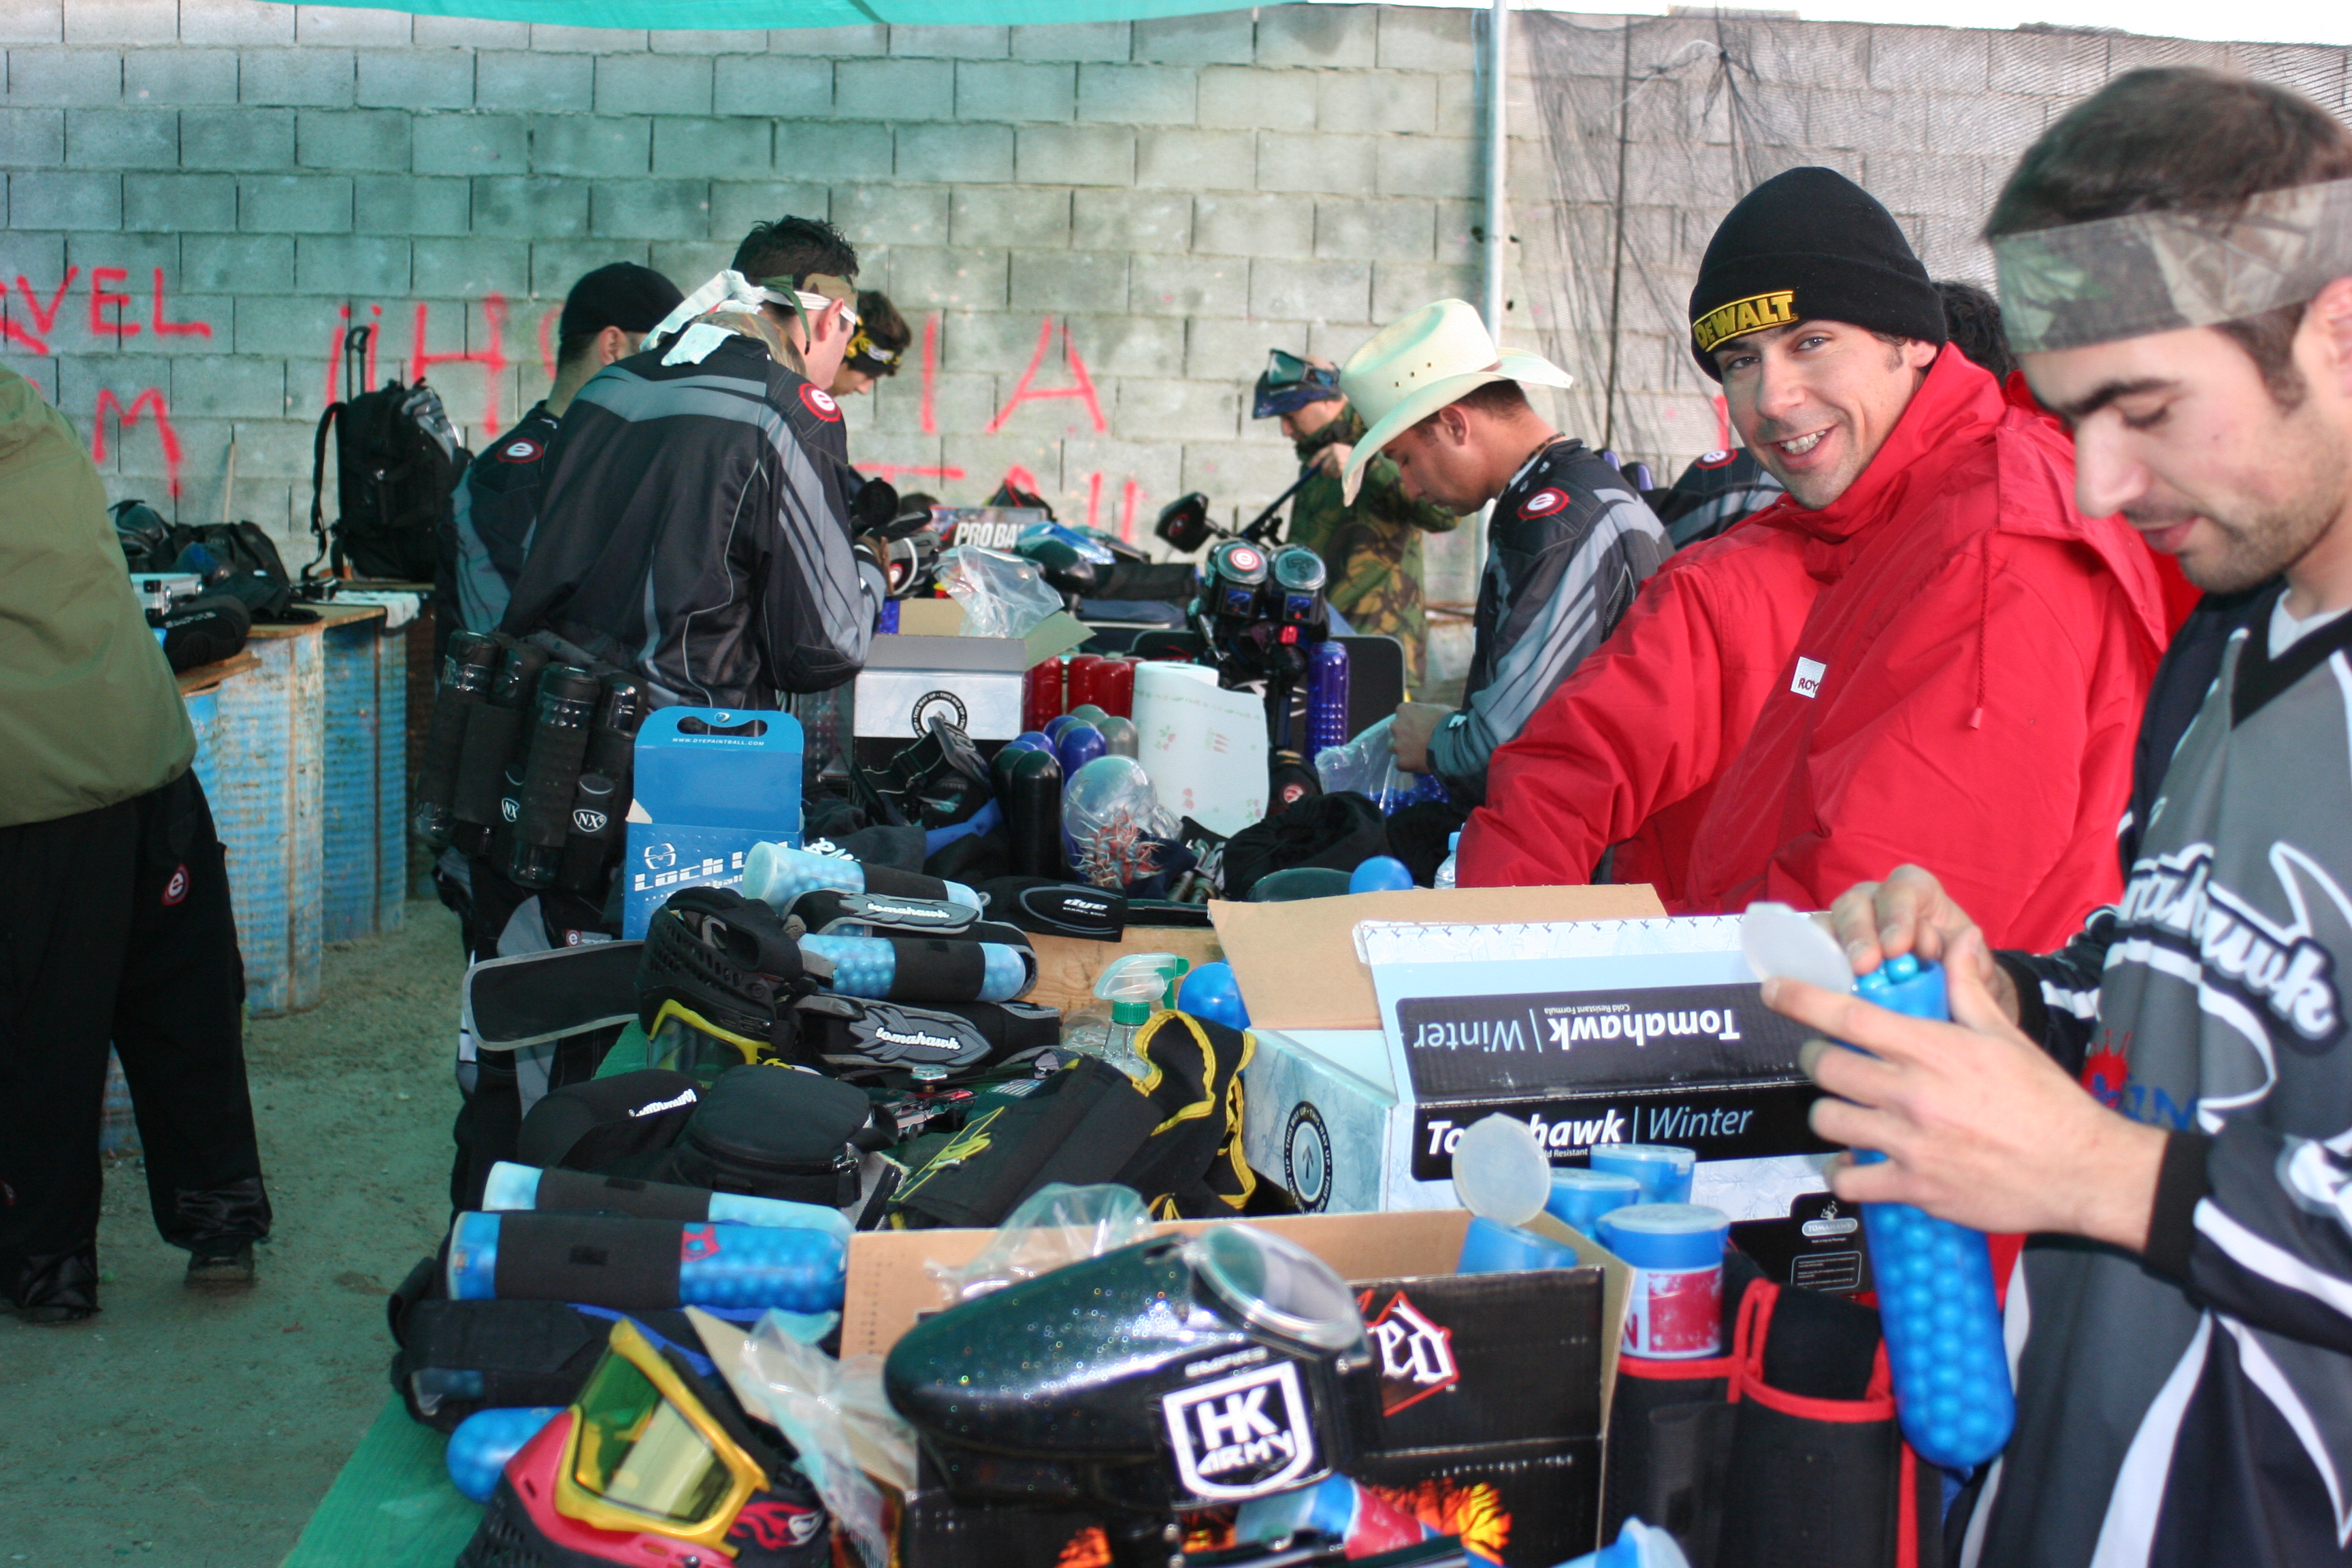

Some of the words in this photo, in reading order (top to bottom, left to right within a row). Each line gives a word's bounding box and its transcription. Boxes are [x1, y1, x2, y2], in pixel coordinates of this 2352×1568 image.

[953, 522, 994, 546] PRO
[672, 737, 765, 746] WWW.DYEPAINTBALL.COM
[875, 1026, 962, 1050] tomahawk
[1413, 1020, 1526, 1054] Winter
[1548, 1009, 1741, 1051] Tomahawk
[1426, 1109, 1626, 1156] Tohawk
[1648, 1104, 1754, 1140] Winter
[1554, 1148, 1588, 1158] Resistant
[1196, 1385, 1279, 1451] HK
[1197, 1429, 1297, 1475] ARMY
